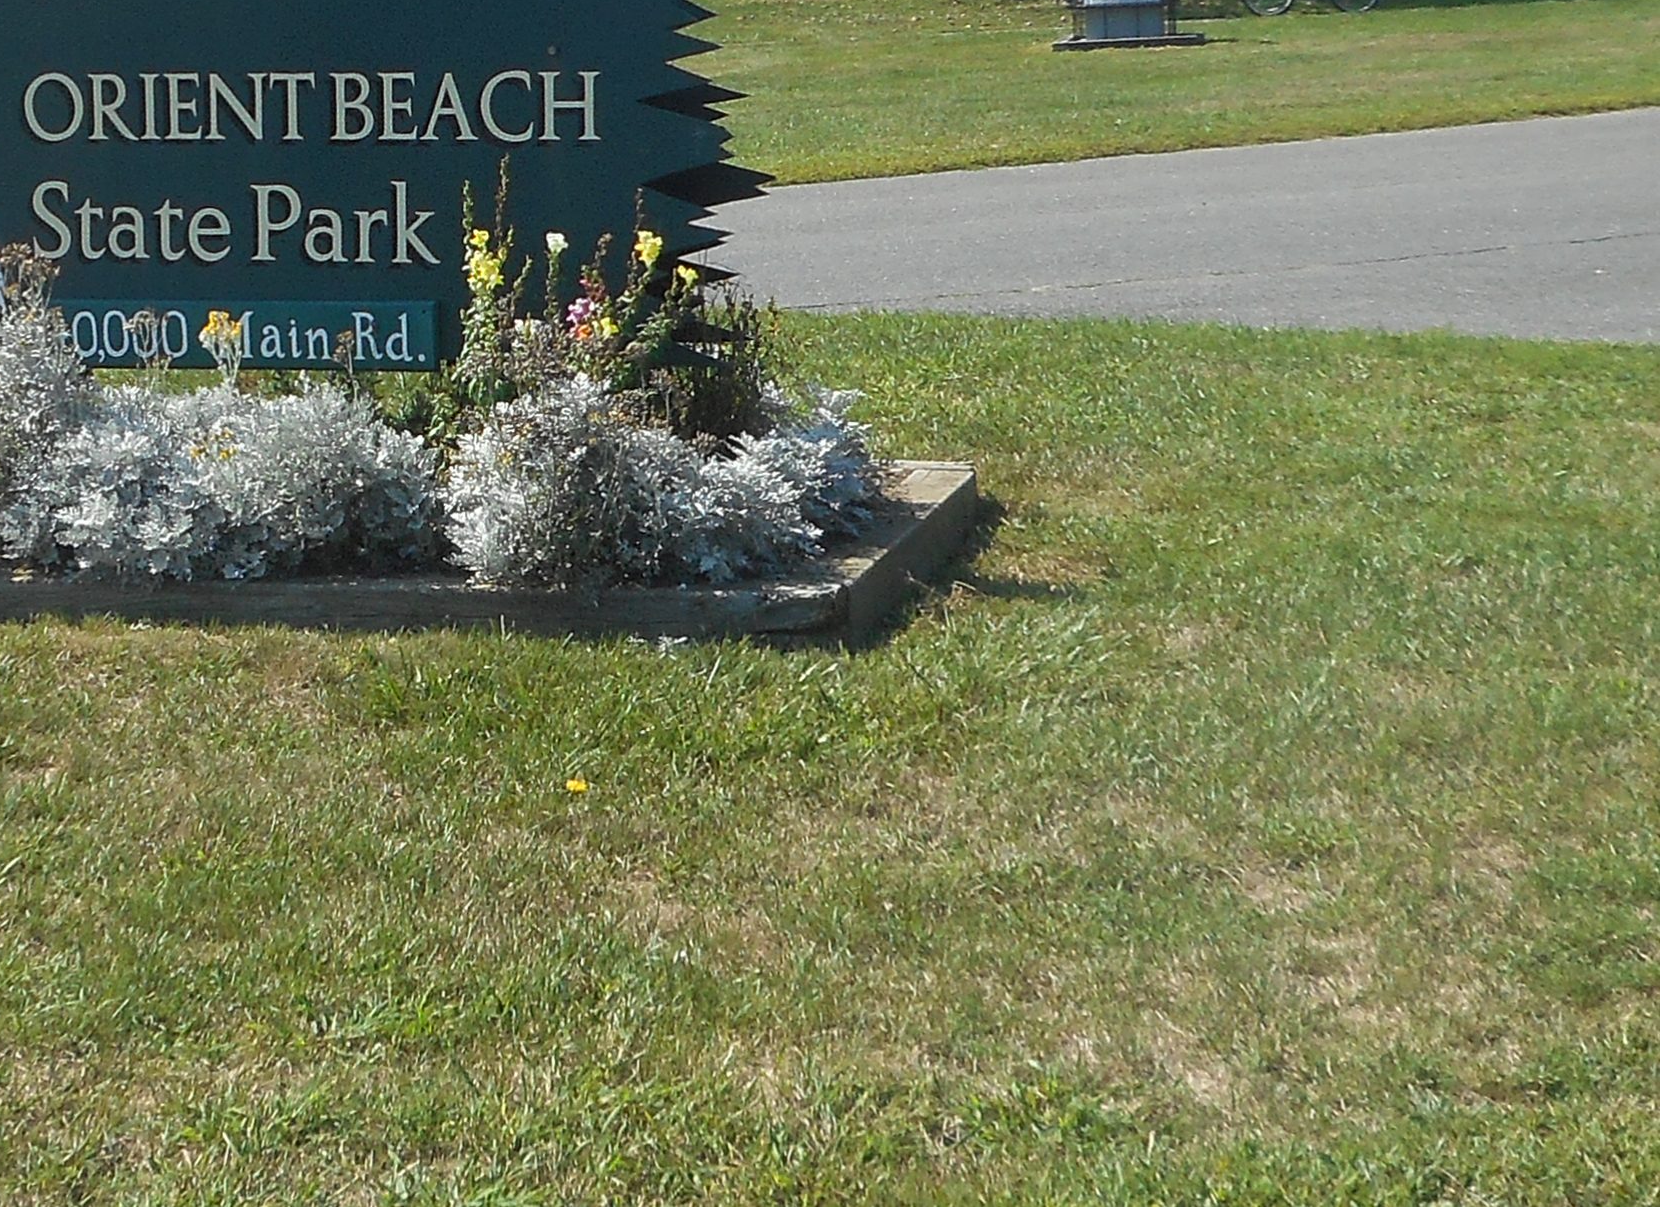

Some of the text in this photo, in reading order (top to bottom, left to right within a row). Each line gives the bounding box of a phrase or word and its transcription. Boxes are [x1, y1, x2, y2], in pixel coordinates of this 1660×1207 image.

[24, 69, 601, 143] ORIENT BEACH
[32, 180, 441, 265] State Park
[352, 311, 426, 363] Rd.
